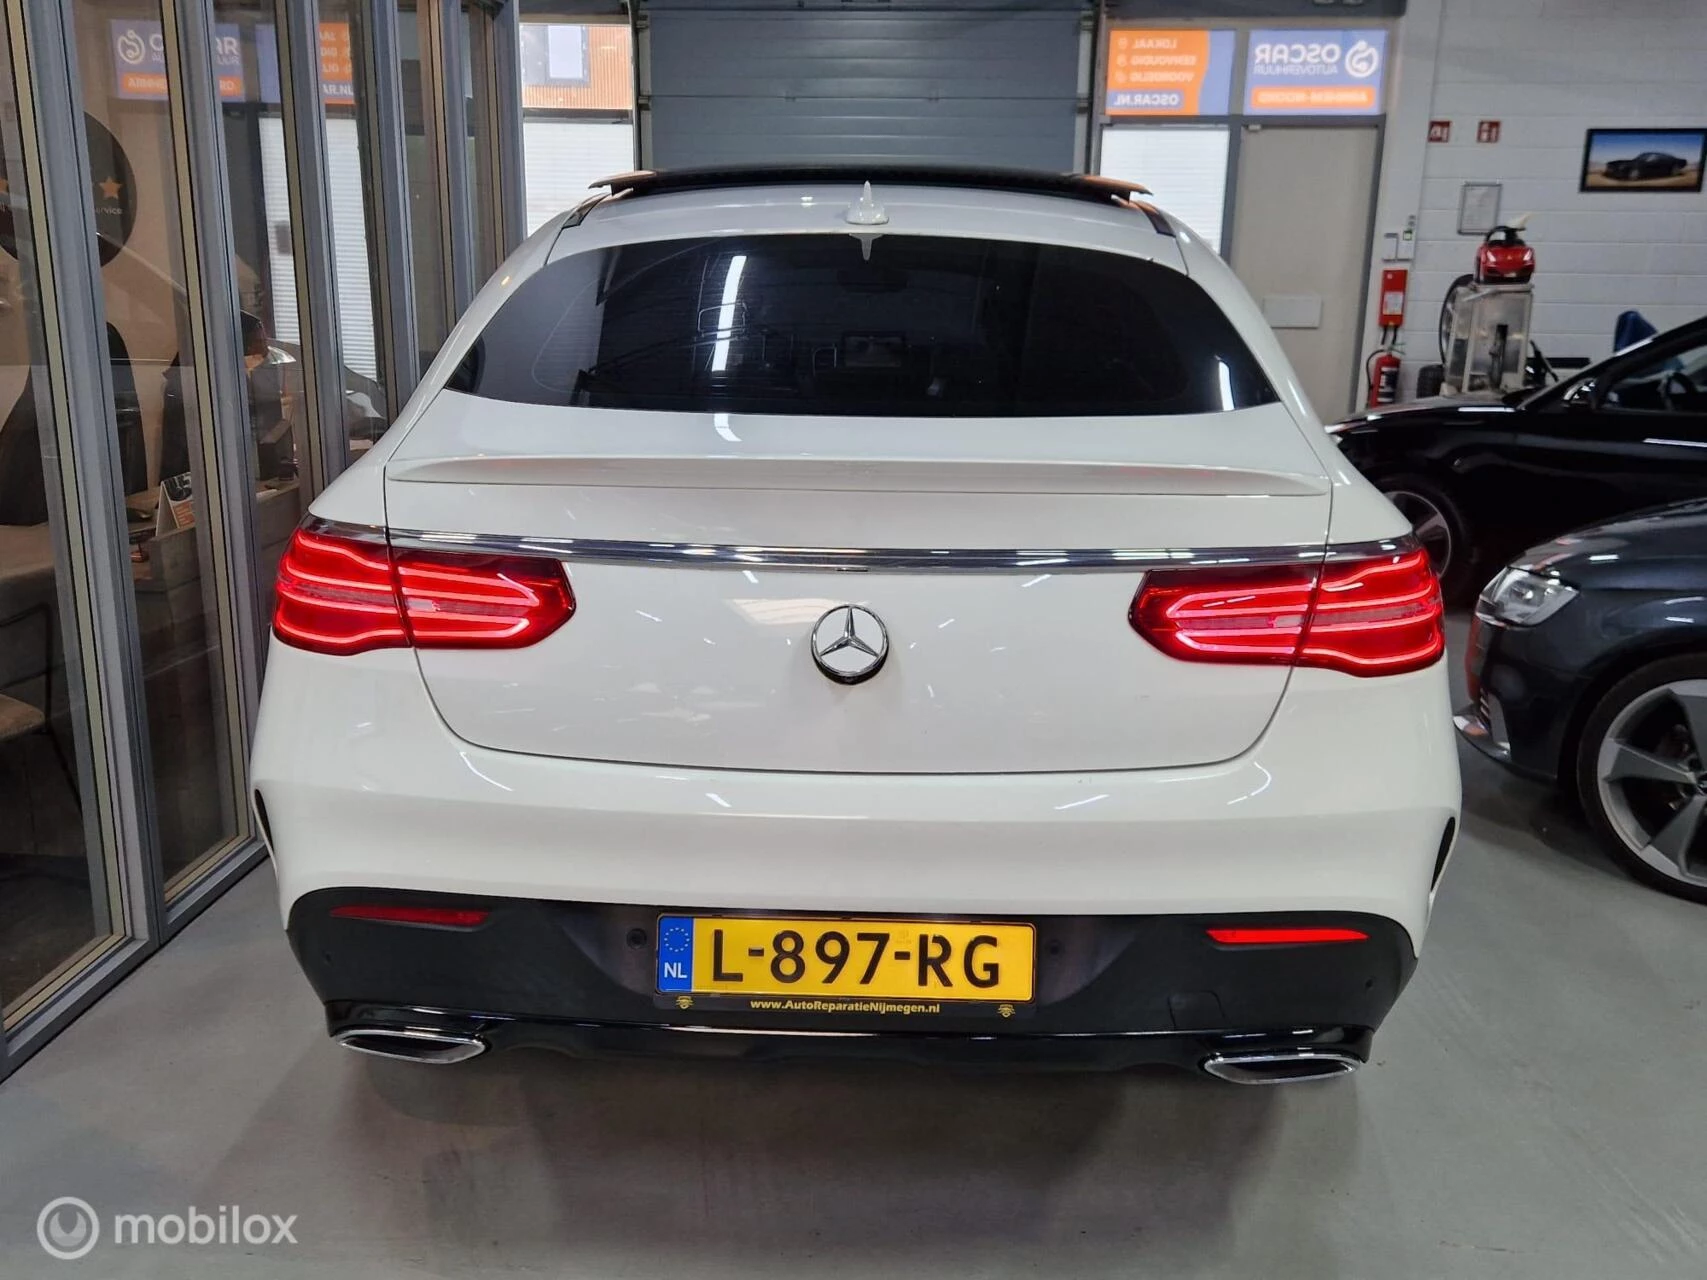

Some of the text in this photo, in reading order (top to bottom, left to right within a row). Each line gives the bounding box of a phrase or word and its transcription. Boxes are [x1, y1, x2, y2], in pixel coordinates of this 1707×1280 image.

[712, 929, 1000, 988] L-897-RG
[664, 962, 688, 979] NL
[750, 999, 941, 1016] www.AutoReparatieNijmegen.nl
